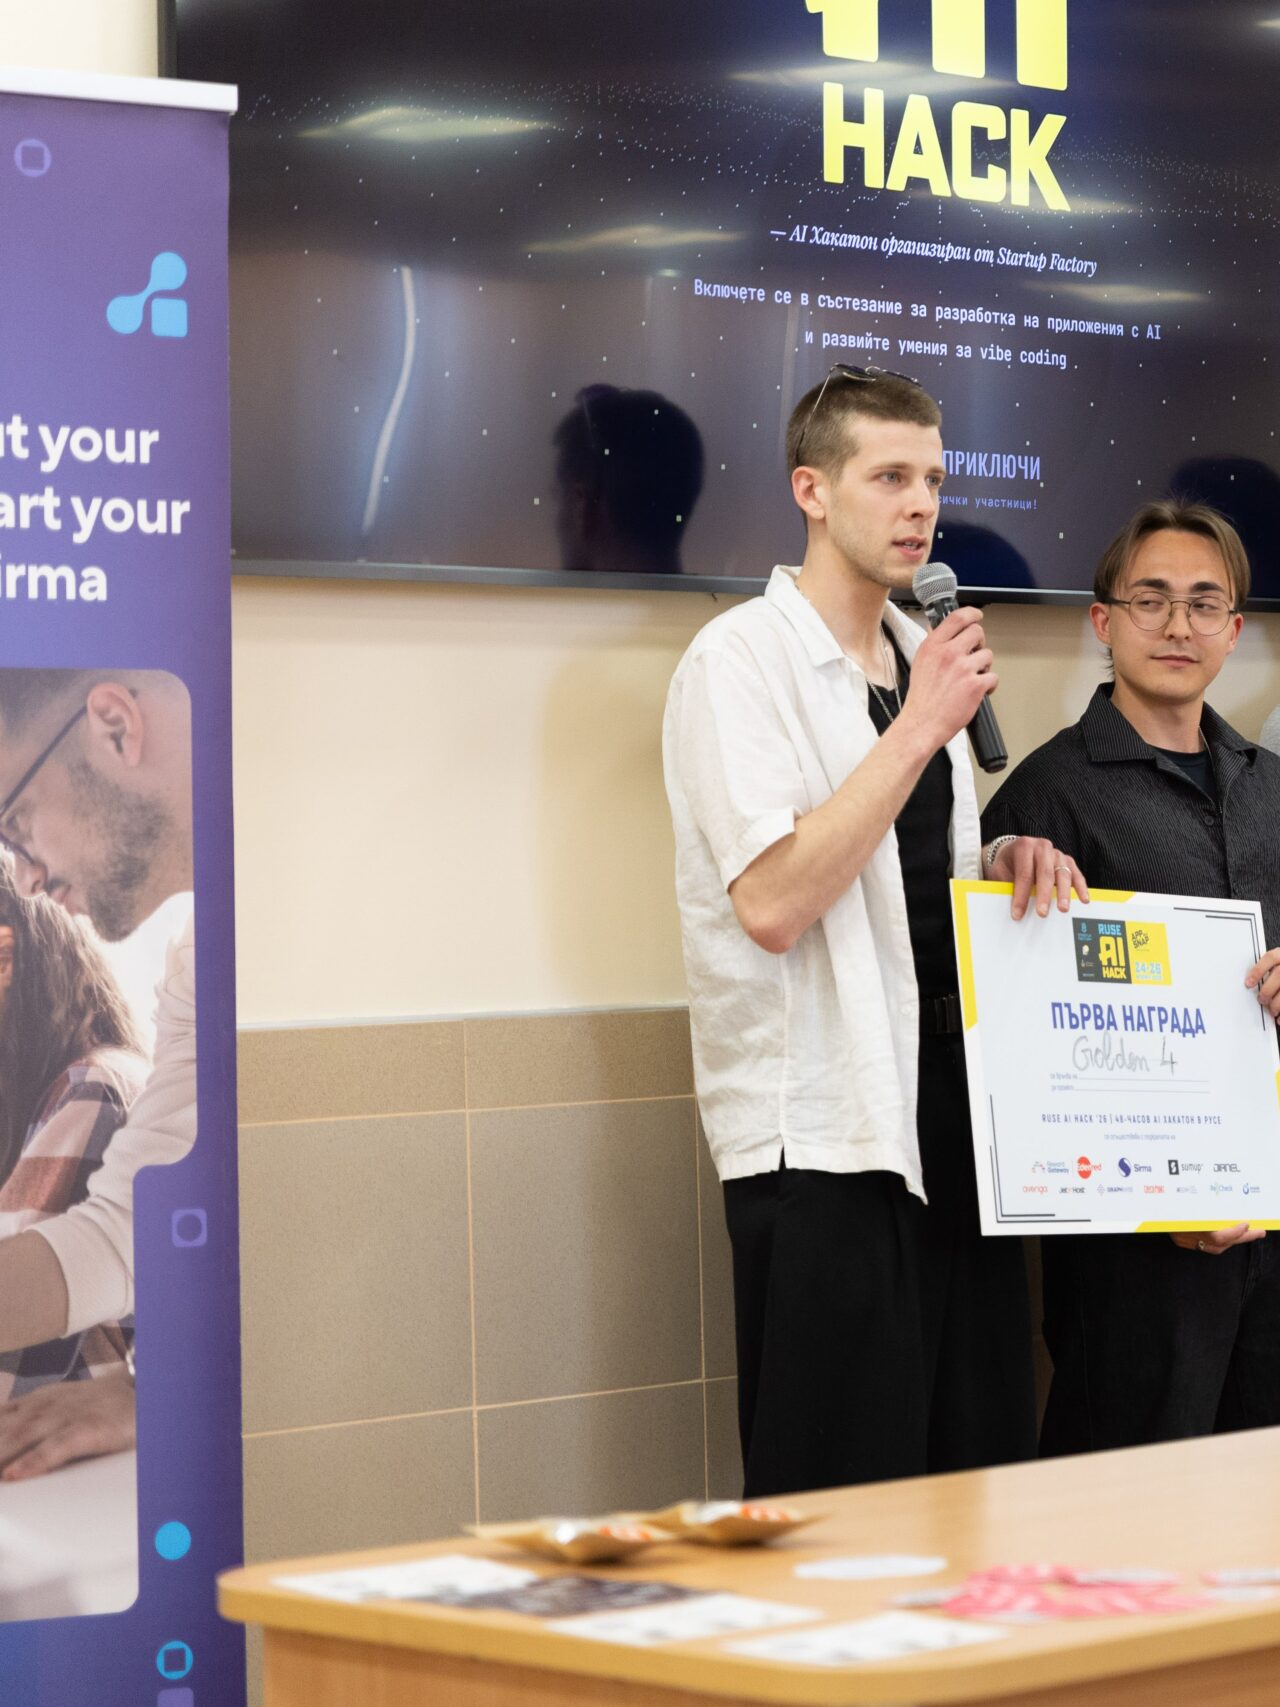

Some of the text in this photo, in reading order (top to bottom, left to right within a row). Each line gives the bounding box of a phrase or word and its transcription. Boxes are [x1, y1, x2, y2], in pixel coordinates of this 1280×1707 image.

[822, 82, 1071, 211] HACK
[789, 224, 808, 242] AI
[809, 225, 878, 250] Хакатон
[881, 235, 971, 261] организиран
[974, 248, 994, 263] от
[997, 247, 1047, 272] Startup
[1049, 253, 1097, 278] Factory
[694, 278, 1161, 340] Включете се в състезание за разработка на приложения с AI
[805, 331, 1067, 370] и развийте умения за vibe coding
[38, 424, 160, 473] your
[942, 449, 1041, 480] ПРИКЛЮЧИ
[71, 495, 191, 544] your
[975, 497, 1038, 510] участници!
[0, 555, 107, 601] rma
[1098, 923, 1122, 935] RUSE
[1098, 936, 1126, 966] AI
[1102, 966, 1127, 979] HACK
[1051, 1002, 1206, 1038] ПЪРВА НАГРАДА
[1072, 1030, 1178, 1076] Golden 4
[1041, 1113, 1061, 1123] RUSE
[1075, 1114, 1094, 1123] HACK
[1163, 1115, 1195, 1125] ХАКАТОН
[1204, 1115, 1222, 1125] РУСЕ
[1134, 1164, 1152, 1173] Sirma
